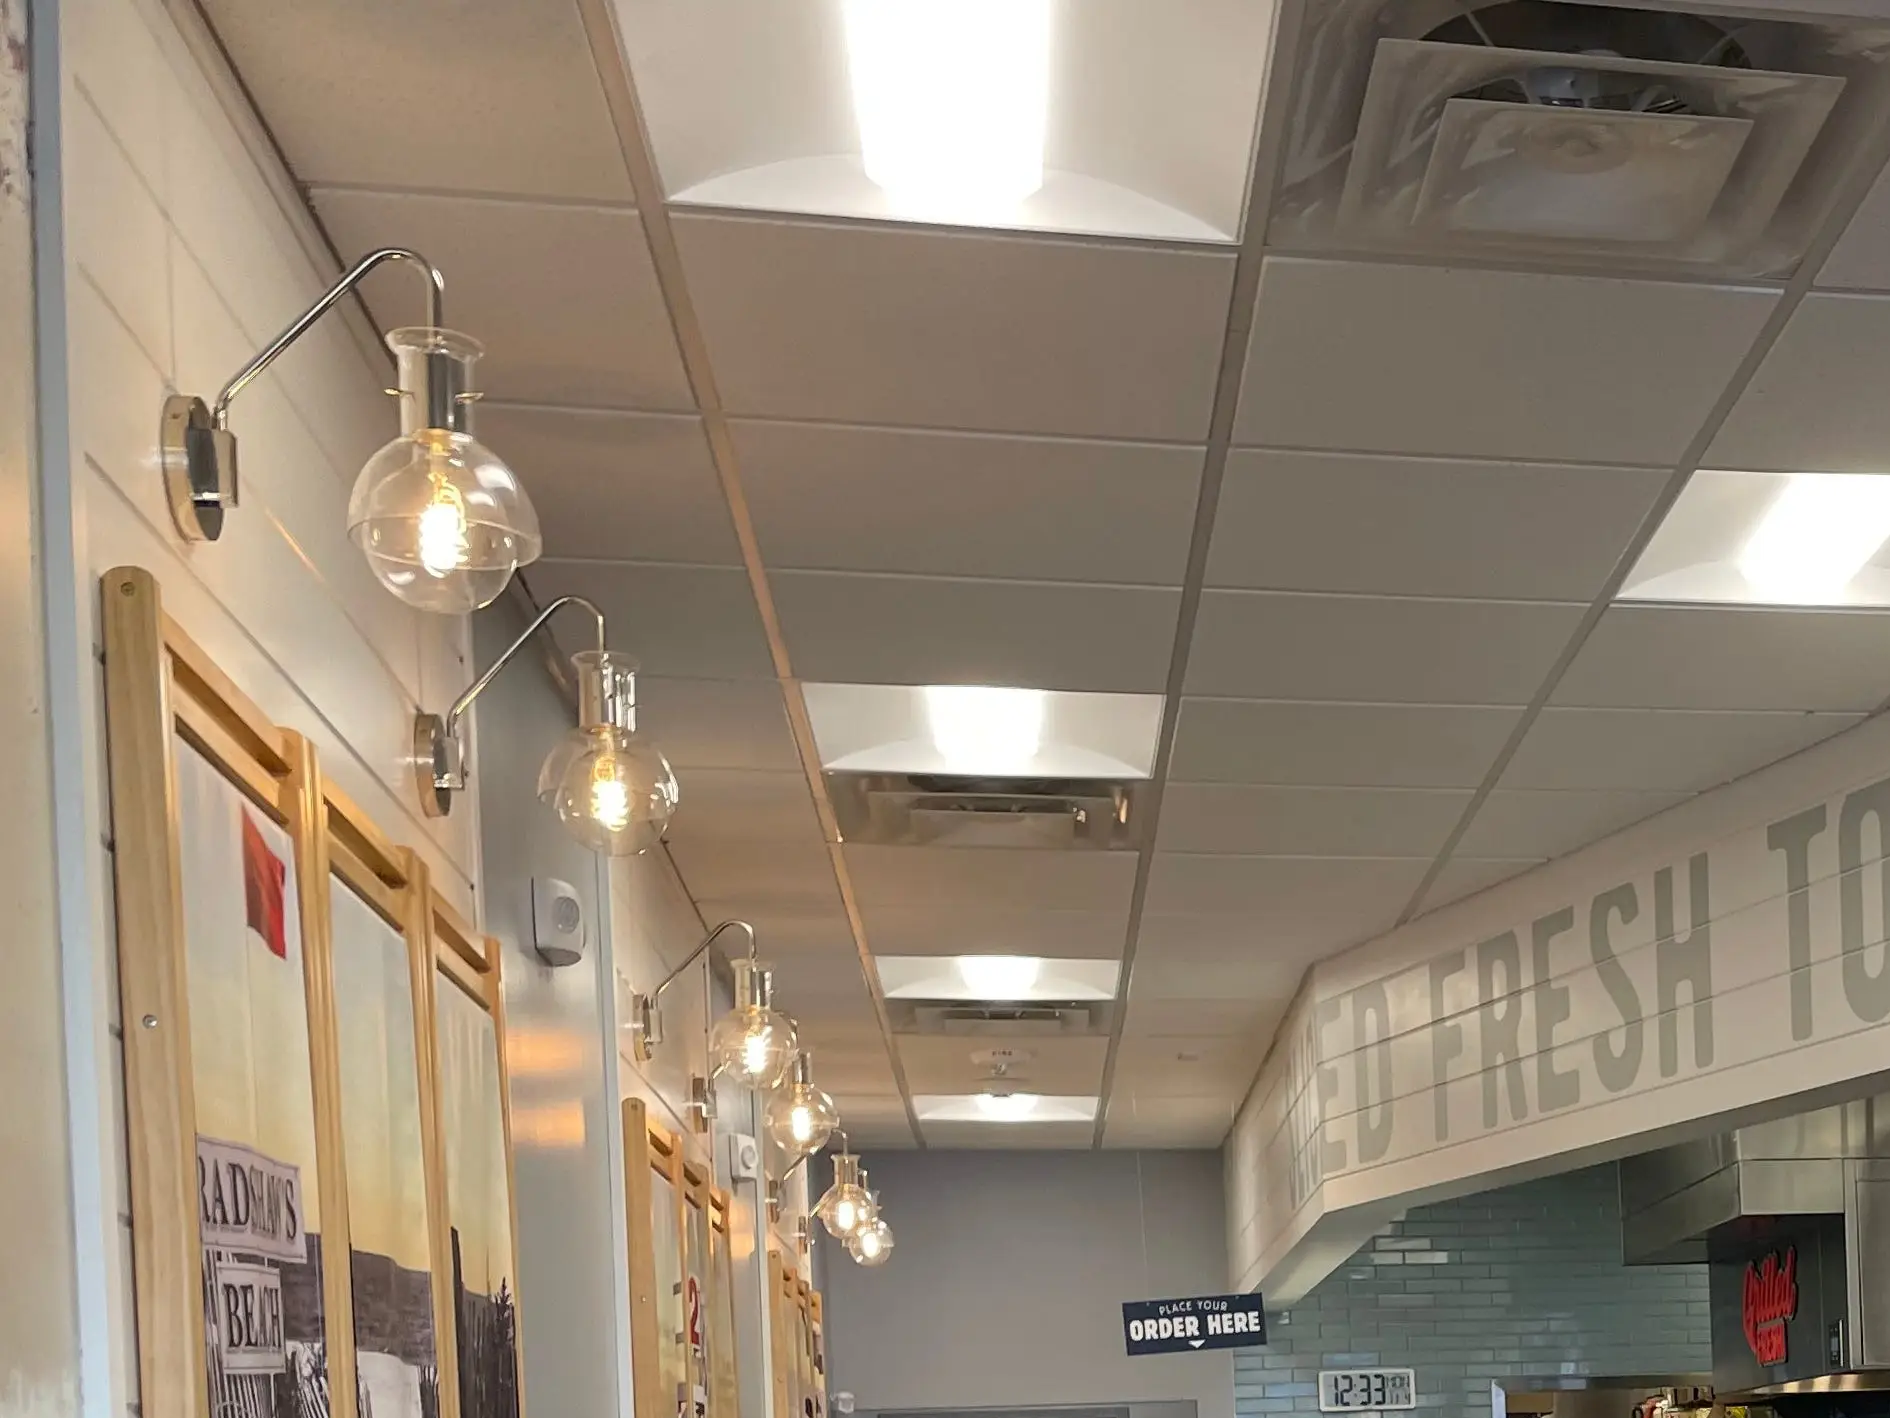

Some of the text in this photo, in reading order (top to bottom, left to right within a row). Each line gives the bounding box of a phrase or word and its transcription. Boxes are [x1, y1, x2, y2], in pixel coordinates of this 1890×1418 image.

[1427, 851, 1713, 1144] FRESH
[223, 1283, 281, 1349] BEACH
[1158, 1300, 1228, 1316] PLACE YOUR
[1129, 1310, 1261, 1342] ORDER HERE
[1332, 1374, 1386, 1407] 12:33
